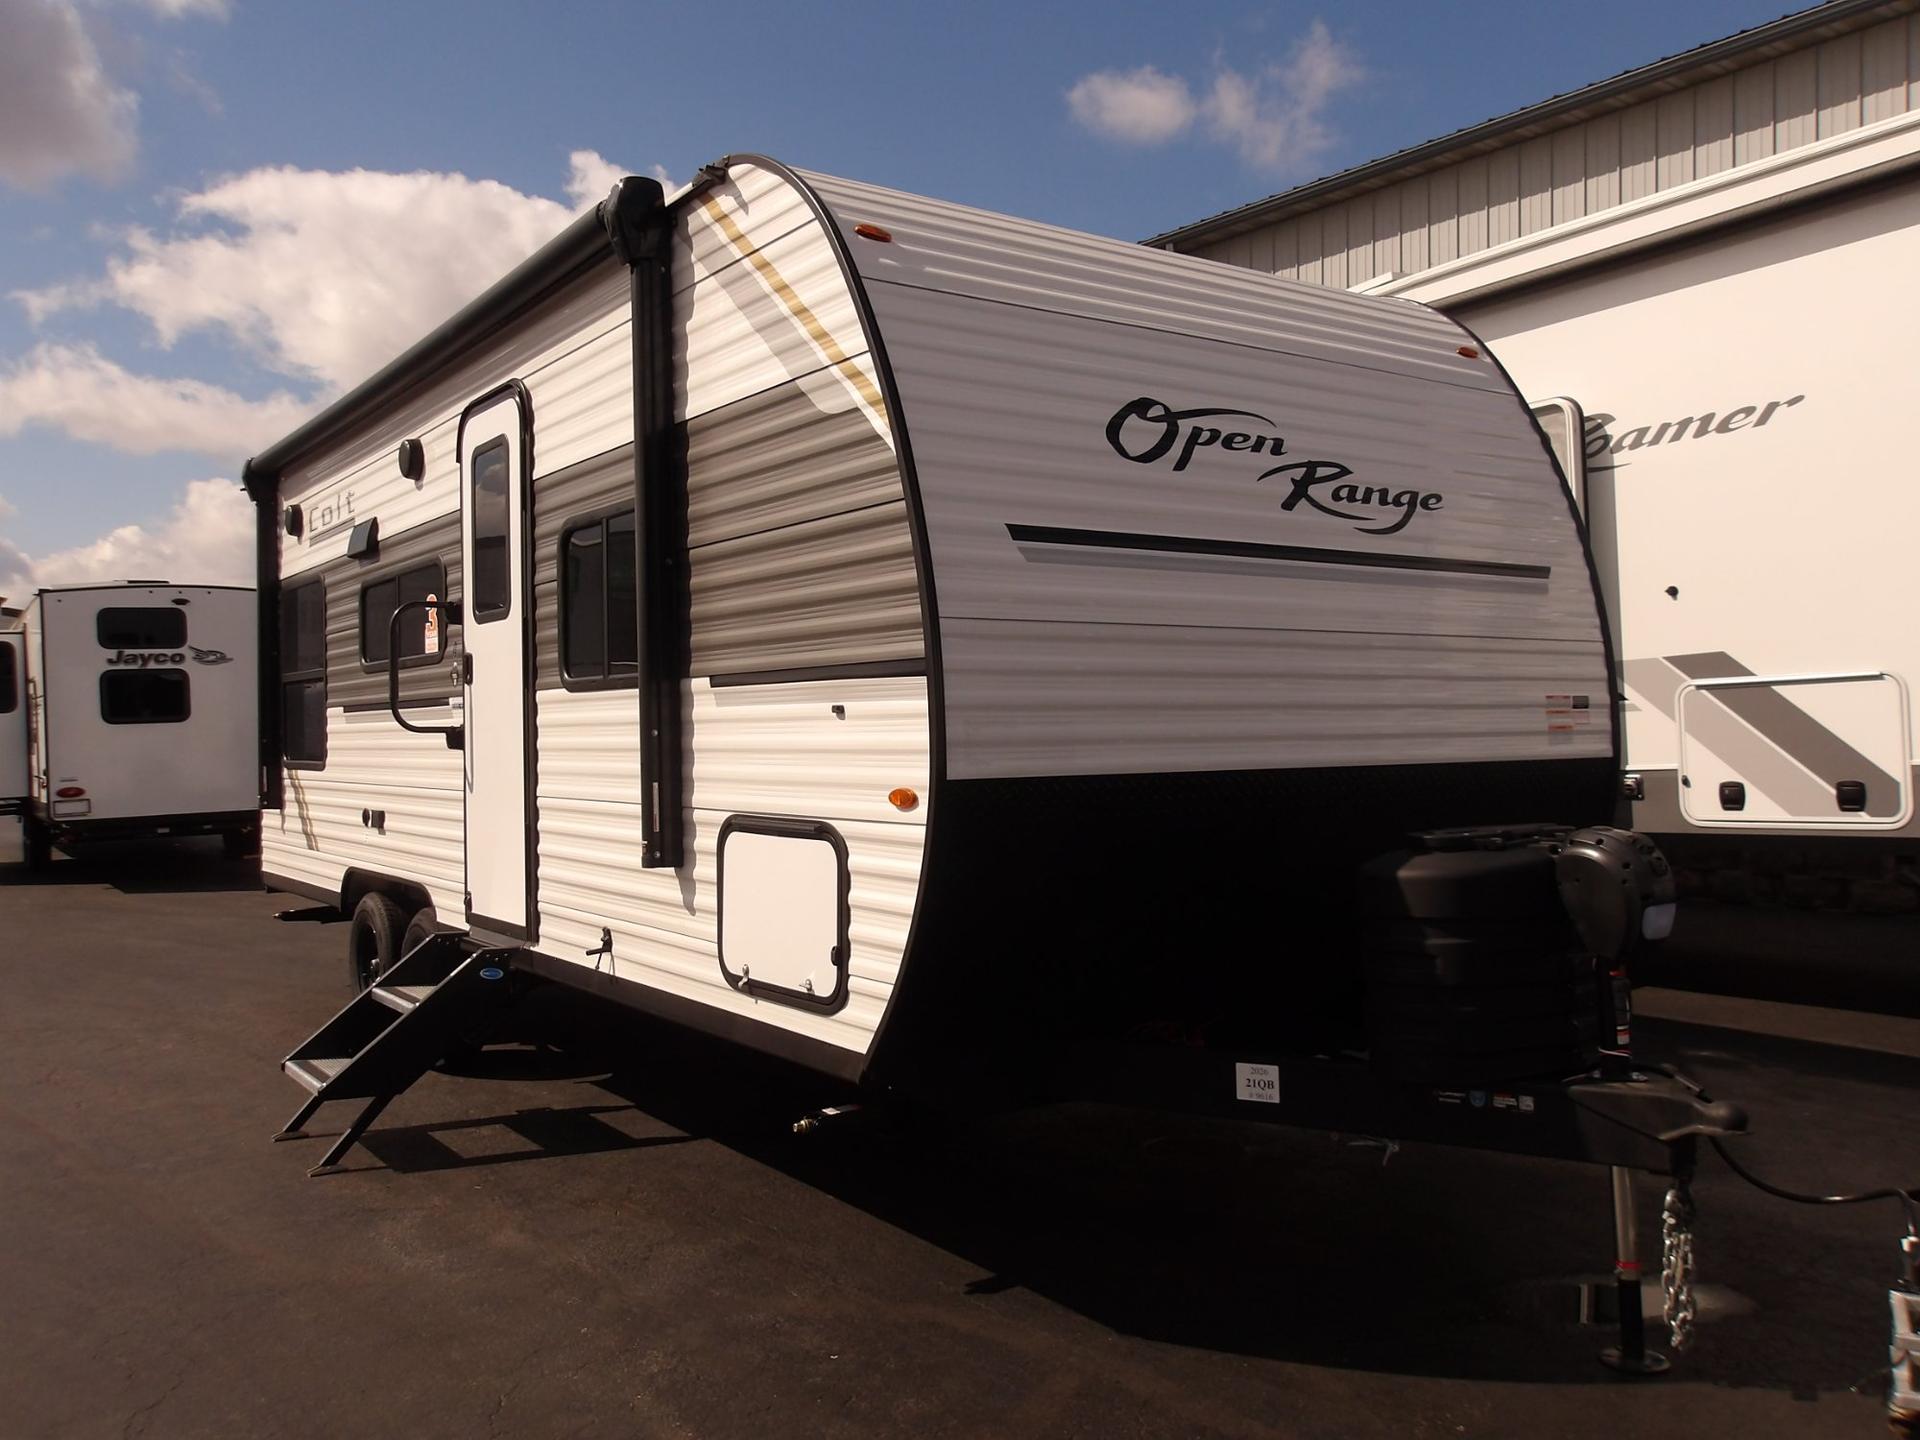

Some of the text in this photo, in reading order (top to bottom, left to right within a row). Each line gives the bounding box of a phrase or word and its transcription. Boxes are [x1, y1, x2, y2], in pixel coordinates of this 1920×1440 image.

[1106, 397, 1288, 472] Open
[309, 490, 355, 533] Colt
[1257, 460, 1444, 535] Range
[106, 650, 186, 668] Jayco
[1245, 1078, 1275, 1091] 21QB
